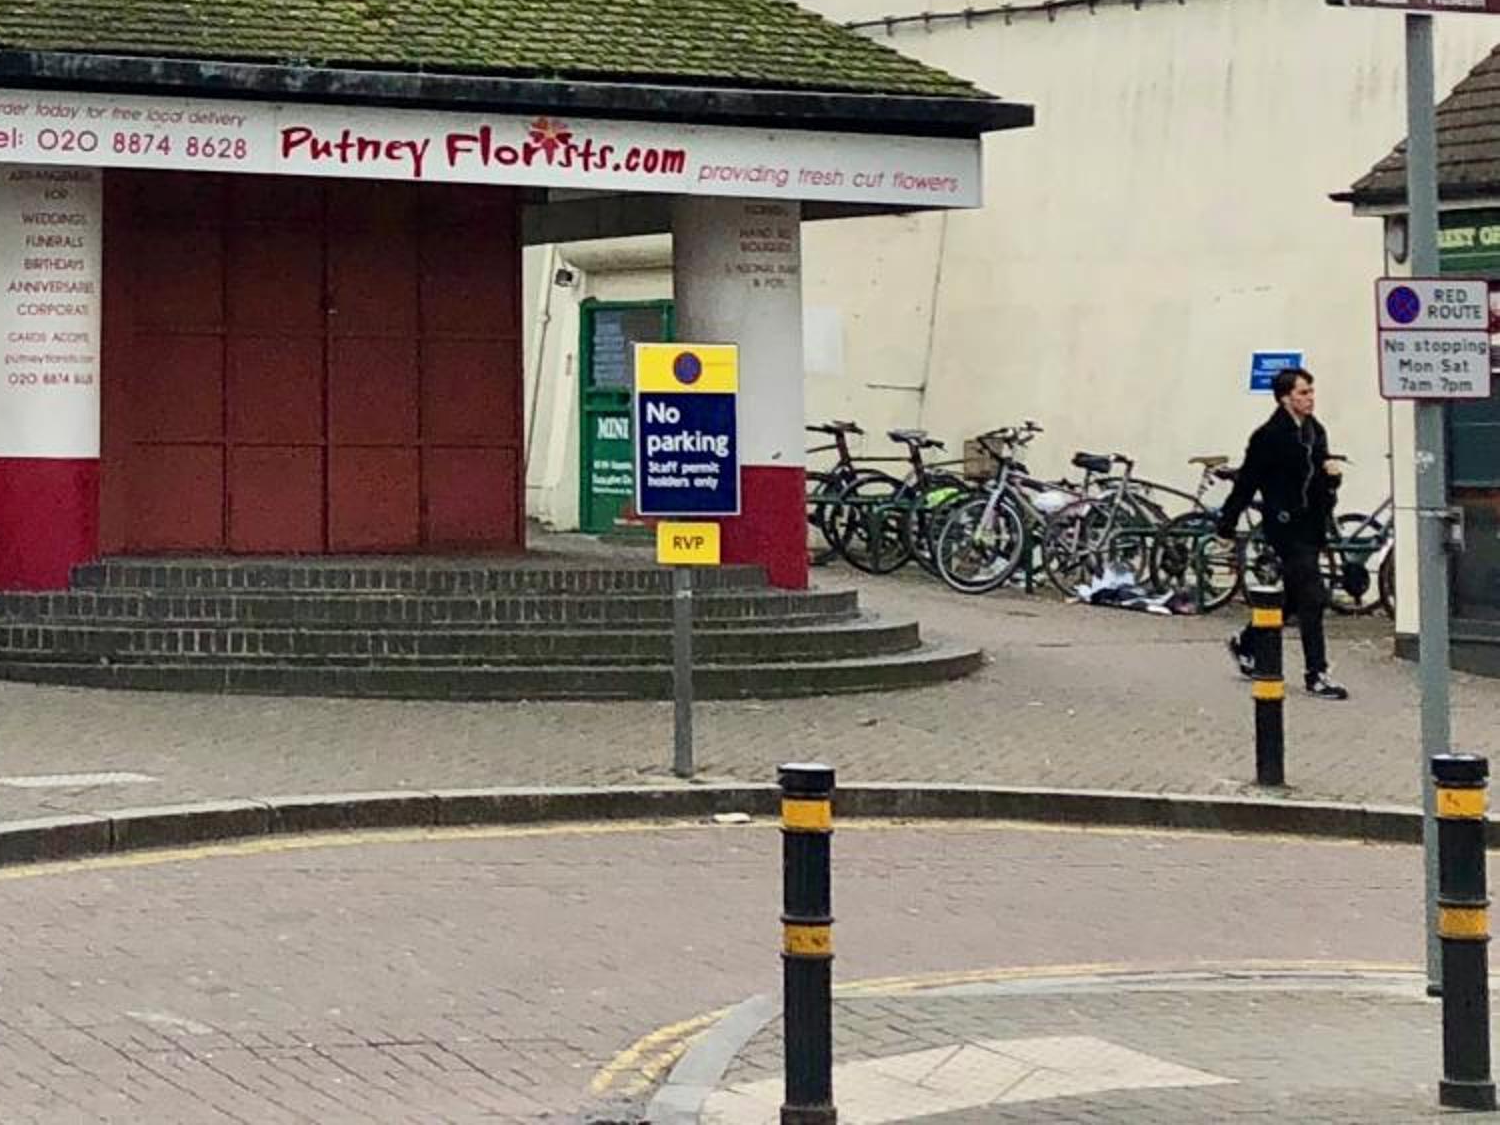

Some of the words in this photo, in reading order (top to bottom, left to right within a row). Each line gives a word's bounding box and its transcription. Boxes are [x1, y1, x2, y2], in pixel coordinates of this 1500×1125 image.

[36, 101, 79, 120] today
[87, 105, 107, 118] for
[111, 106, 143, 121] free
[147, 107, 183, 123] local
[188, 108, 247, 127] delivery
[37, 128, 99, 152] 020
[112, 132, 173, 156] 8874
[186, 135, 248, 160] 8628
[280, 126, 431, 178] Putney
[446, 124, 687, 174] Florists.com
[698, 164, 790, 187] providing
[798, 167, 843, 187] fresh
[852, 171, 885, 188] cut
[25, 234, 85, 249] FUNERALS
[23, 258, 85, 271] BIRTHDAYS
[1433, 288, 1468, 304] RED
[1427, 304, 1483, 320] ROUTE
[1384, 339, 1405, 353] No
[1414, 339, 1487, 356] stopping
[1399, 358, 1434, 373] Mon
[1441, 358, 1471, 373] Sat
[1399, 377, 1433, 392] 7am
[1441, 377, 1474, 393] 7pm
[645, 401, 681, 424] No
[646, 430, 730, 458] parking
[648, 460, 679, 474] Staff
[681, 461, 721, 476] permit
[647, 475, 691, 488] holders
[693, 475, 719, 491] only
[672, 535, 705, 551] RVP
